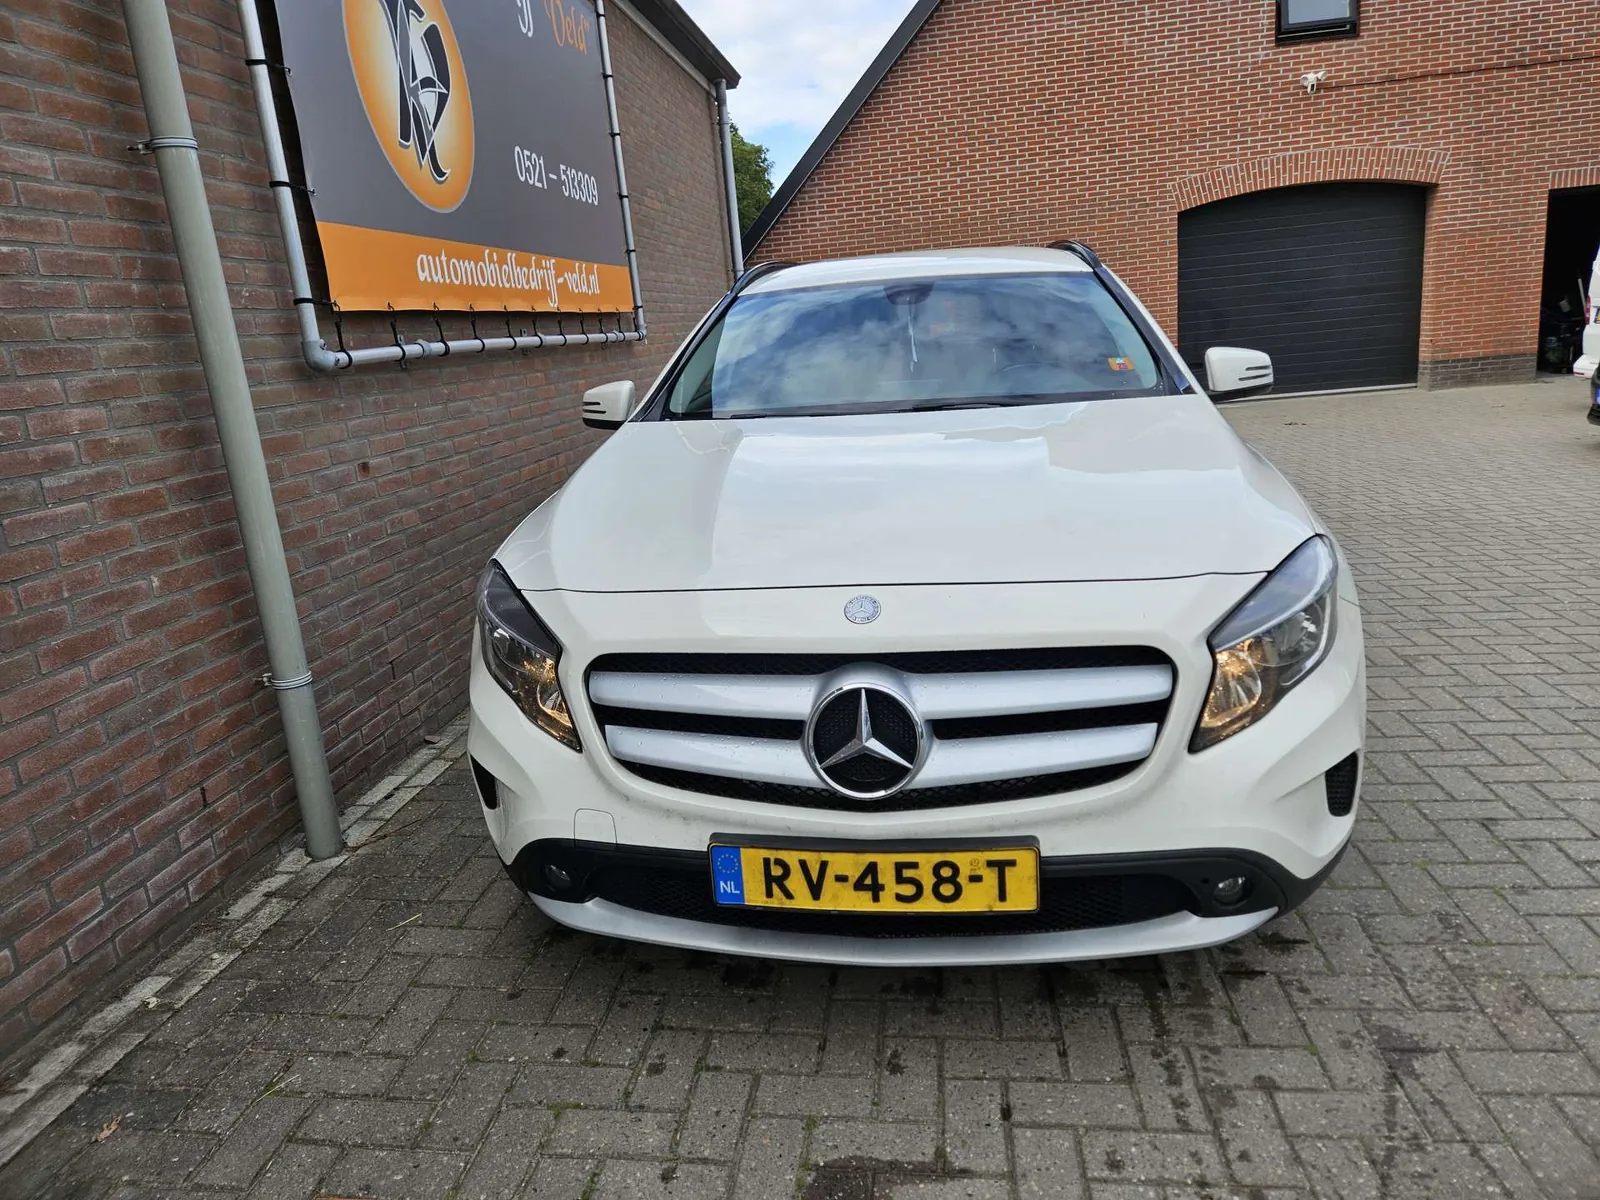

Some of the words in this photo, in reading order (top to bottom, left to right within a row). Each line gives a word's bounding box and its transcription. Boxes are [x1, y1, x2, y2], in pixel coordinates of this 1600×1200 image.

[514, 145, 547, 190] 0521
[560, 163, 599, 206] 513309
[417, 248, 600, 308] automobielbedrijf-veld.nl
[720, 880, 741, 894] NL
[762, 856, 1017, 903] RV-458-T
